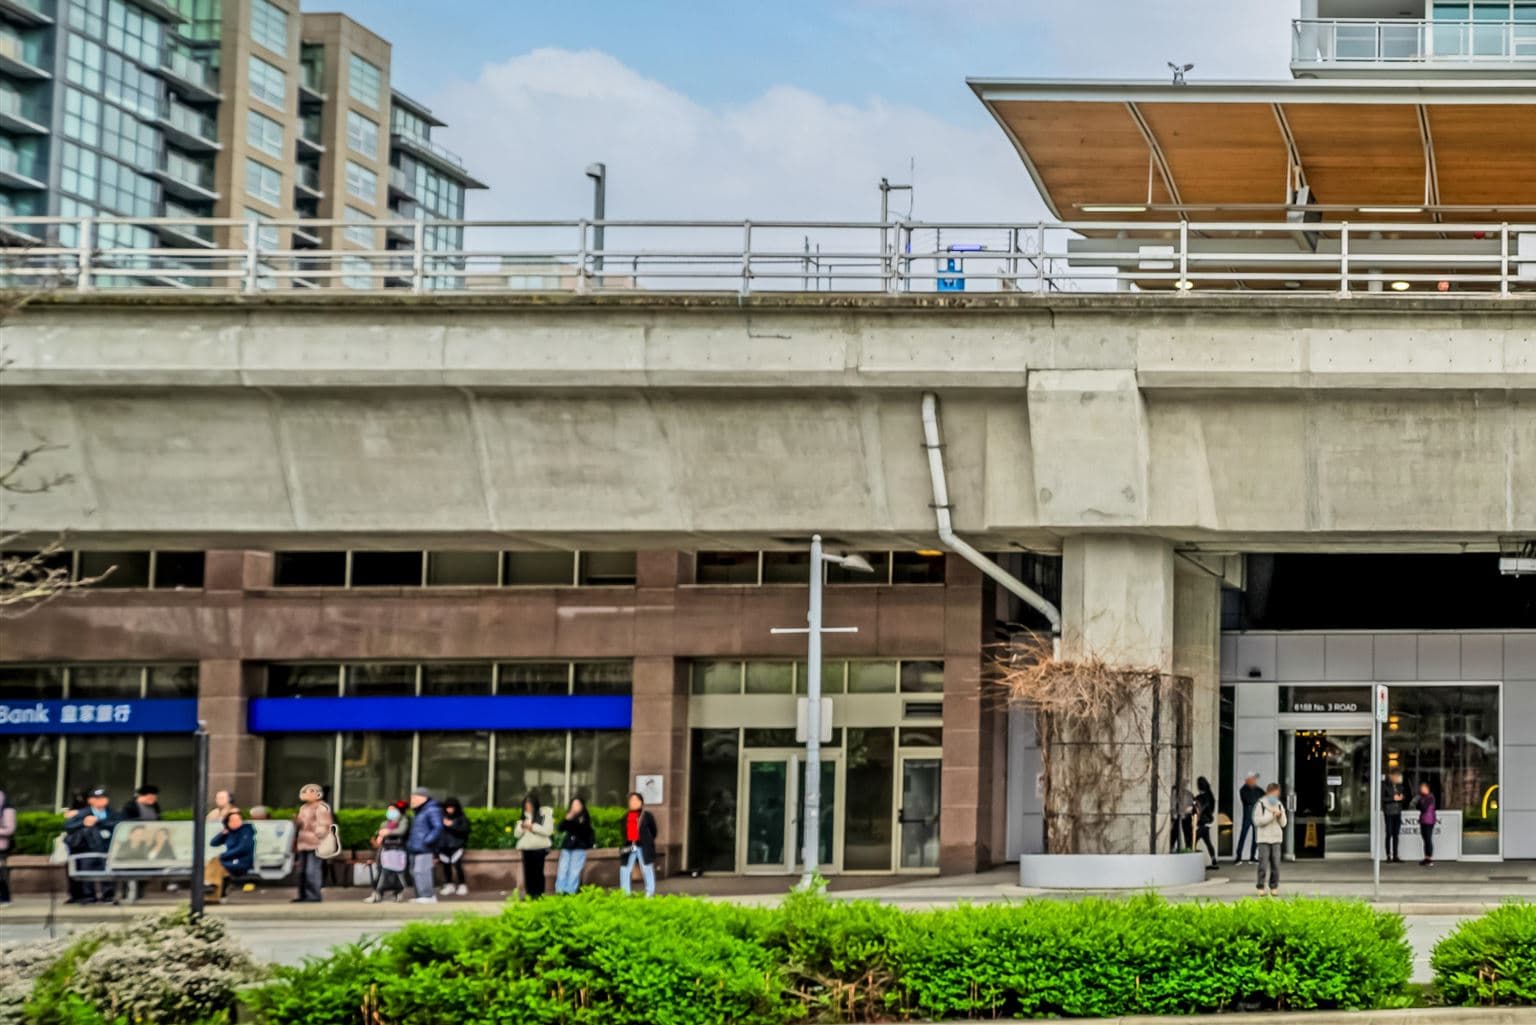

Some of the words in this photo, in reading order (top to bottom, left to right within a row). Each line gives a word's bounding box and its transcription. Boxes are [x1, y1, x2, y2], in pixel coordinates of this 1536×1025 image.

[0, 702, 49, 724] Bank
[1328, 703, 1333, 712] 3
[1334, 703, 1358, 712] ROAD
